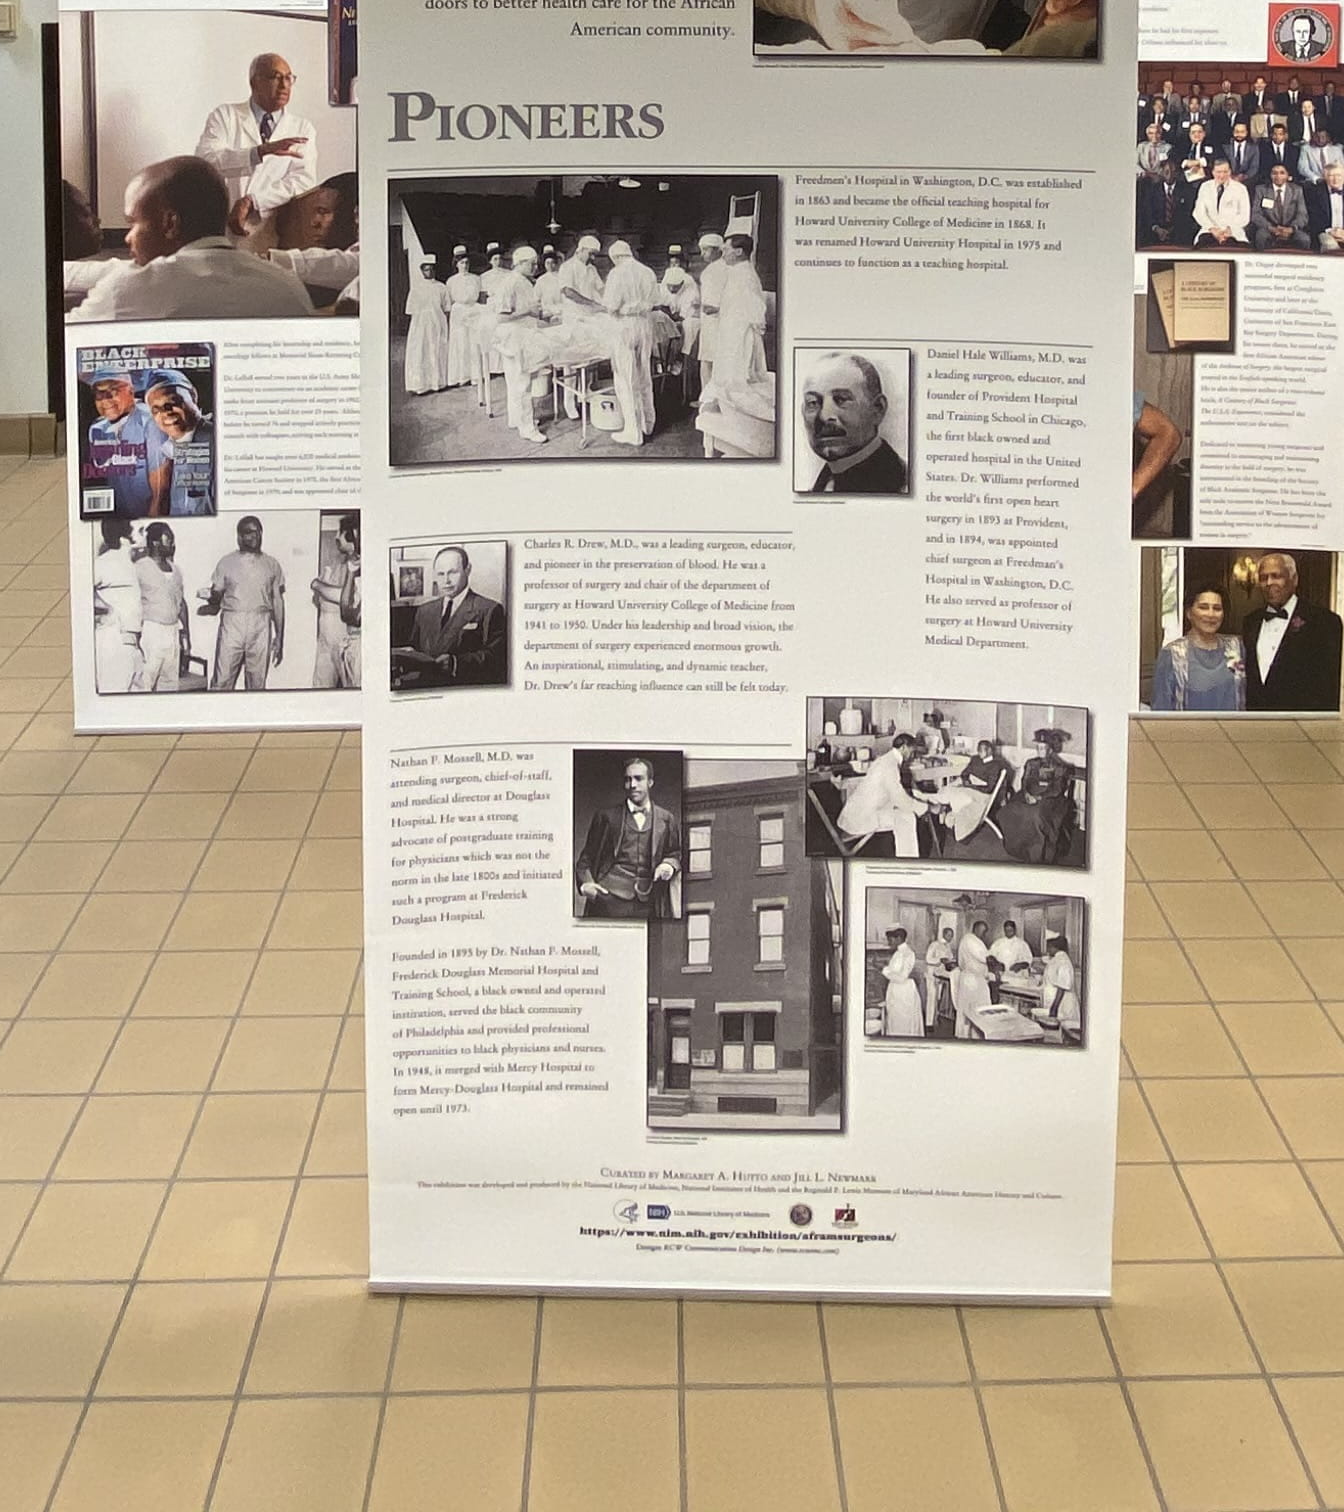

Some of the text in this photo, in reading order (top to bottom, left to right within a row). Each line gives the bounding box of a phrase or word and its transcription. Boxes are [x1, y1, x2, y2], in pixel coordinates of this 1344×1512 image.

[569, 21, 735, 40] American community.
[387, 91, 664, 142] PIONEERS
[795, 174, 852, 185] Freedmen's
[854, 174, 898, 188] Hospital
[899, 175, 910, 186] in
[912, 175, 975, 189] Washington,
[977, 176, 1003, 187] D.C.
[1026, 177, 1082, 189] established
[81, 347, 148, 362] BLACK
[81, 356, 211, 374] ENTERPRISE
[600, 1167, 876, 1184] CURATED BY MARGARET A. HUTTO AND JILL L. NEWMARK
